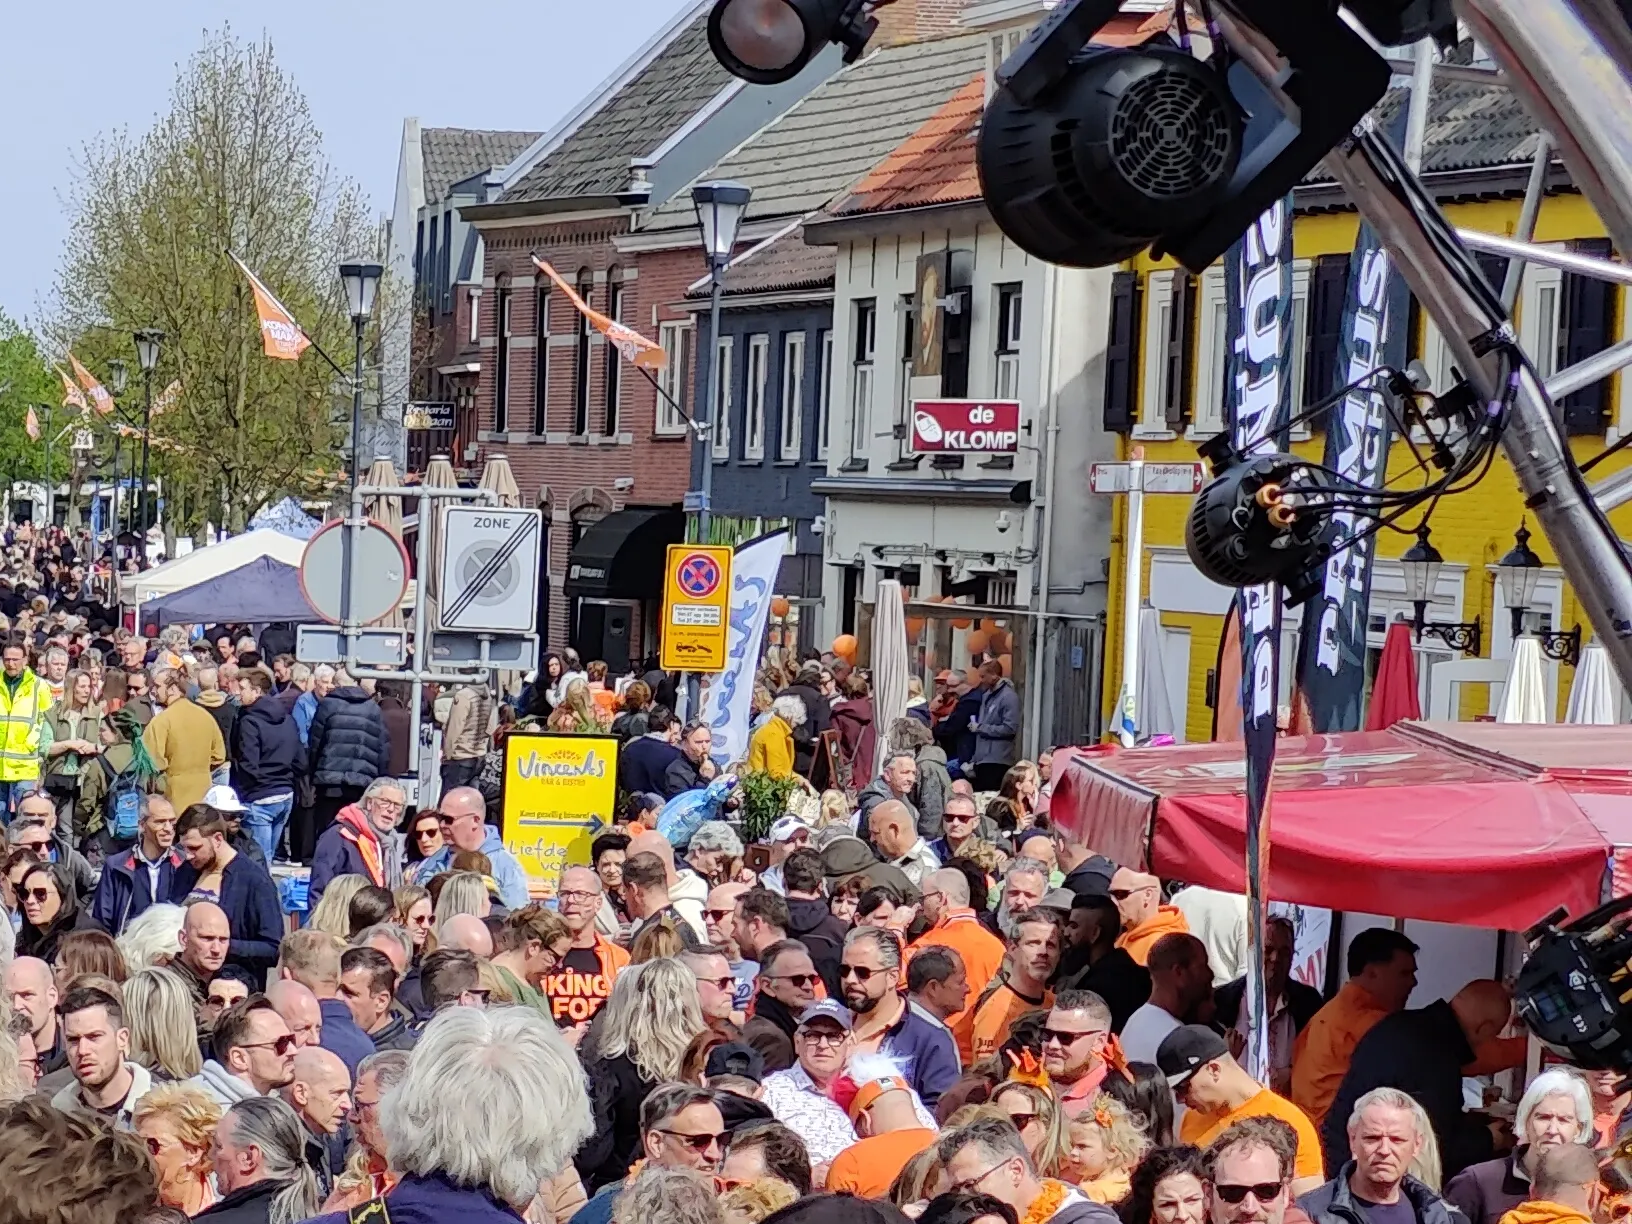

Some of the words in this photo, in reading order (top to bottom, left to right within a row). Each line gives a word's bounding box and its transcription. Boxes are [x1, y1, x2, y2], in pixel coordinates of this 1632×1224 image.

[968, 405, 995, 425] de
[944, 430, 1017, 450] KLOMP
[473, 517, 511, 529] ZONE
[509, 837, 567, 858] Liefde
